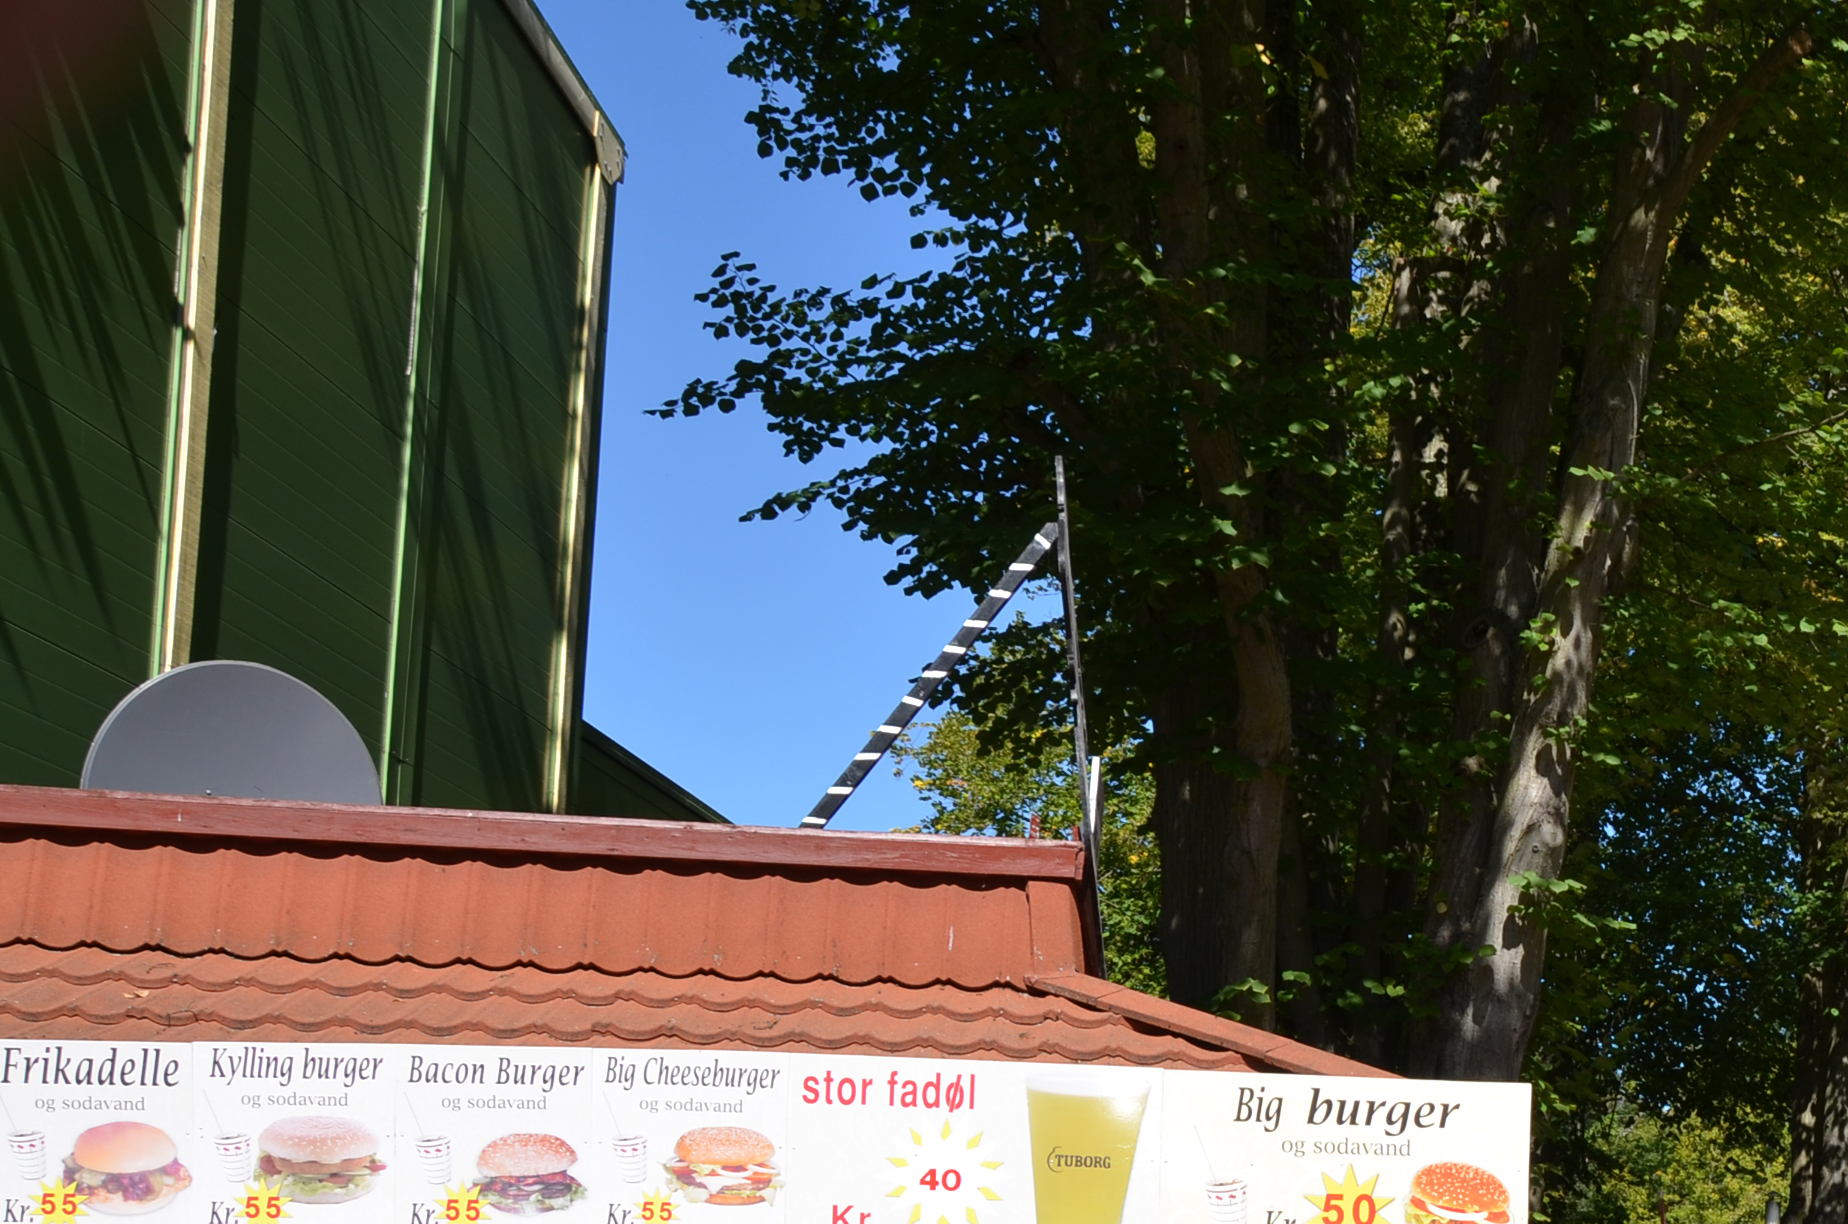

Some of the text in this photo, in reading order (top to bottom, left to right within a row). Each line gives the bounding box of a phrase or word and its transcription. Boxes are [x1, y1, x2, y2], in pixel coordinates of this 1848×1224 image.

[0, 1046, 181, 1088] Frikadelle
[209, 1047, 384, 1087] Kylling burger
[407, 1055, 585, 1093] Bacon Burger
[604, 1056, 781, 1096] Big Cheeseburger
[240, 1091, 349, 1108] og sodavand
[441, 1094, 547, 1111] og sodavand
[802, 1070, 976, 1113] stor fadøl
[34, 1096, 146, 1113] og sodavand
[639, 1097, 744, 1114] og sodavand
[1233, 1086, 1461, 1137] Big burger
[1281, 1137, 1411, 1158] og sodavand
[1055, 1154, 1111, 1169] TUBORG
[919, 1168, 962, 1192] 40
[3, 1199, 34, 1223] Kr.
[209, 1201, 239, 1224] Kr.
